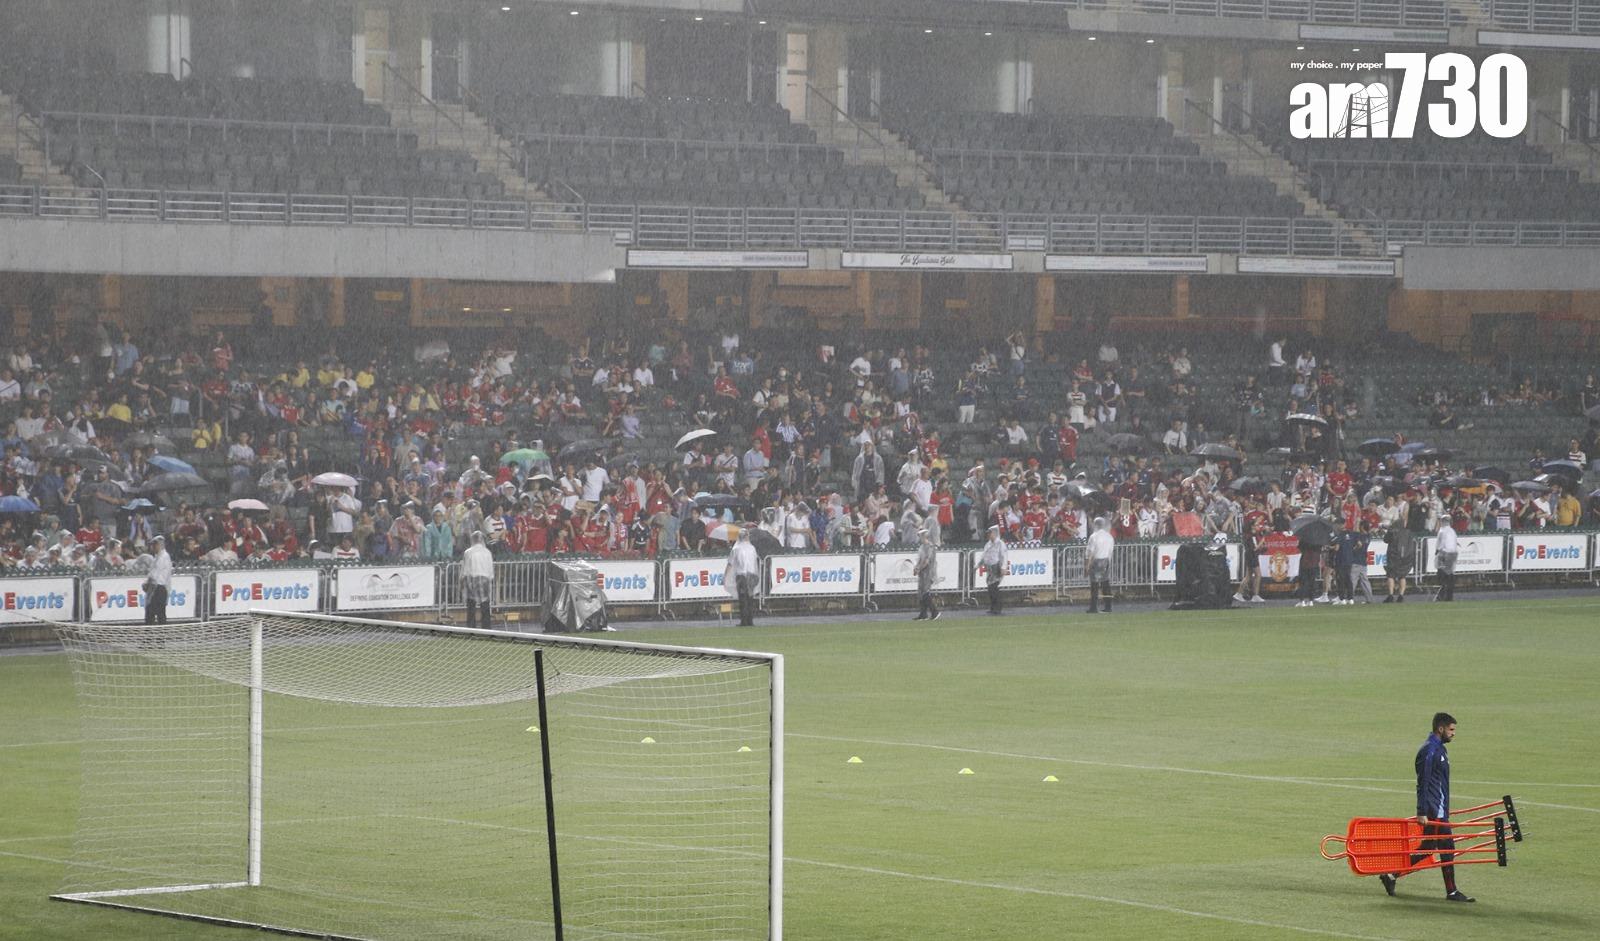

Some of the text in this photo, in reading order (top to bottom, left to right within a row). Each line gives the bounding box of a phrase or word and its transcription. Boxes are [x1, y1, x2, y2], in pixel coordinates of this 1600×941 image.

[1516, 545, 1580, 559] ProEvents
[776, 567, 852, 583] ProEvents
[222, 583, 309, 601] ProEvents
